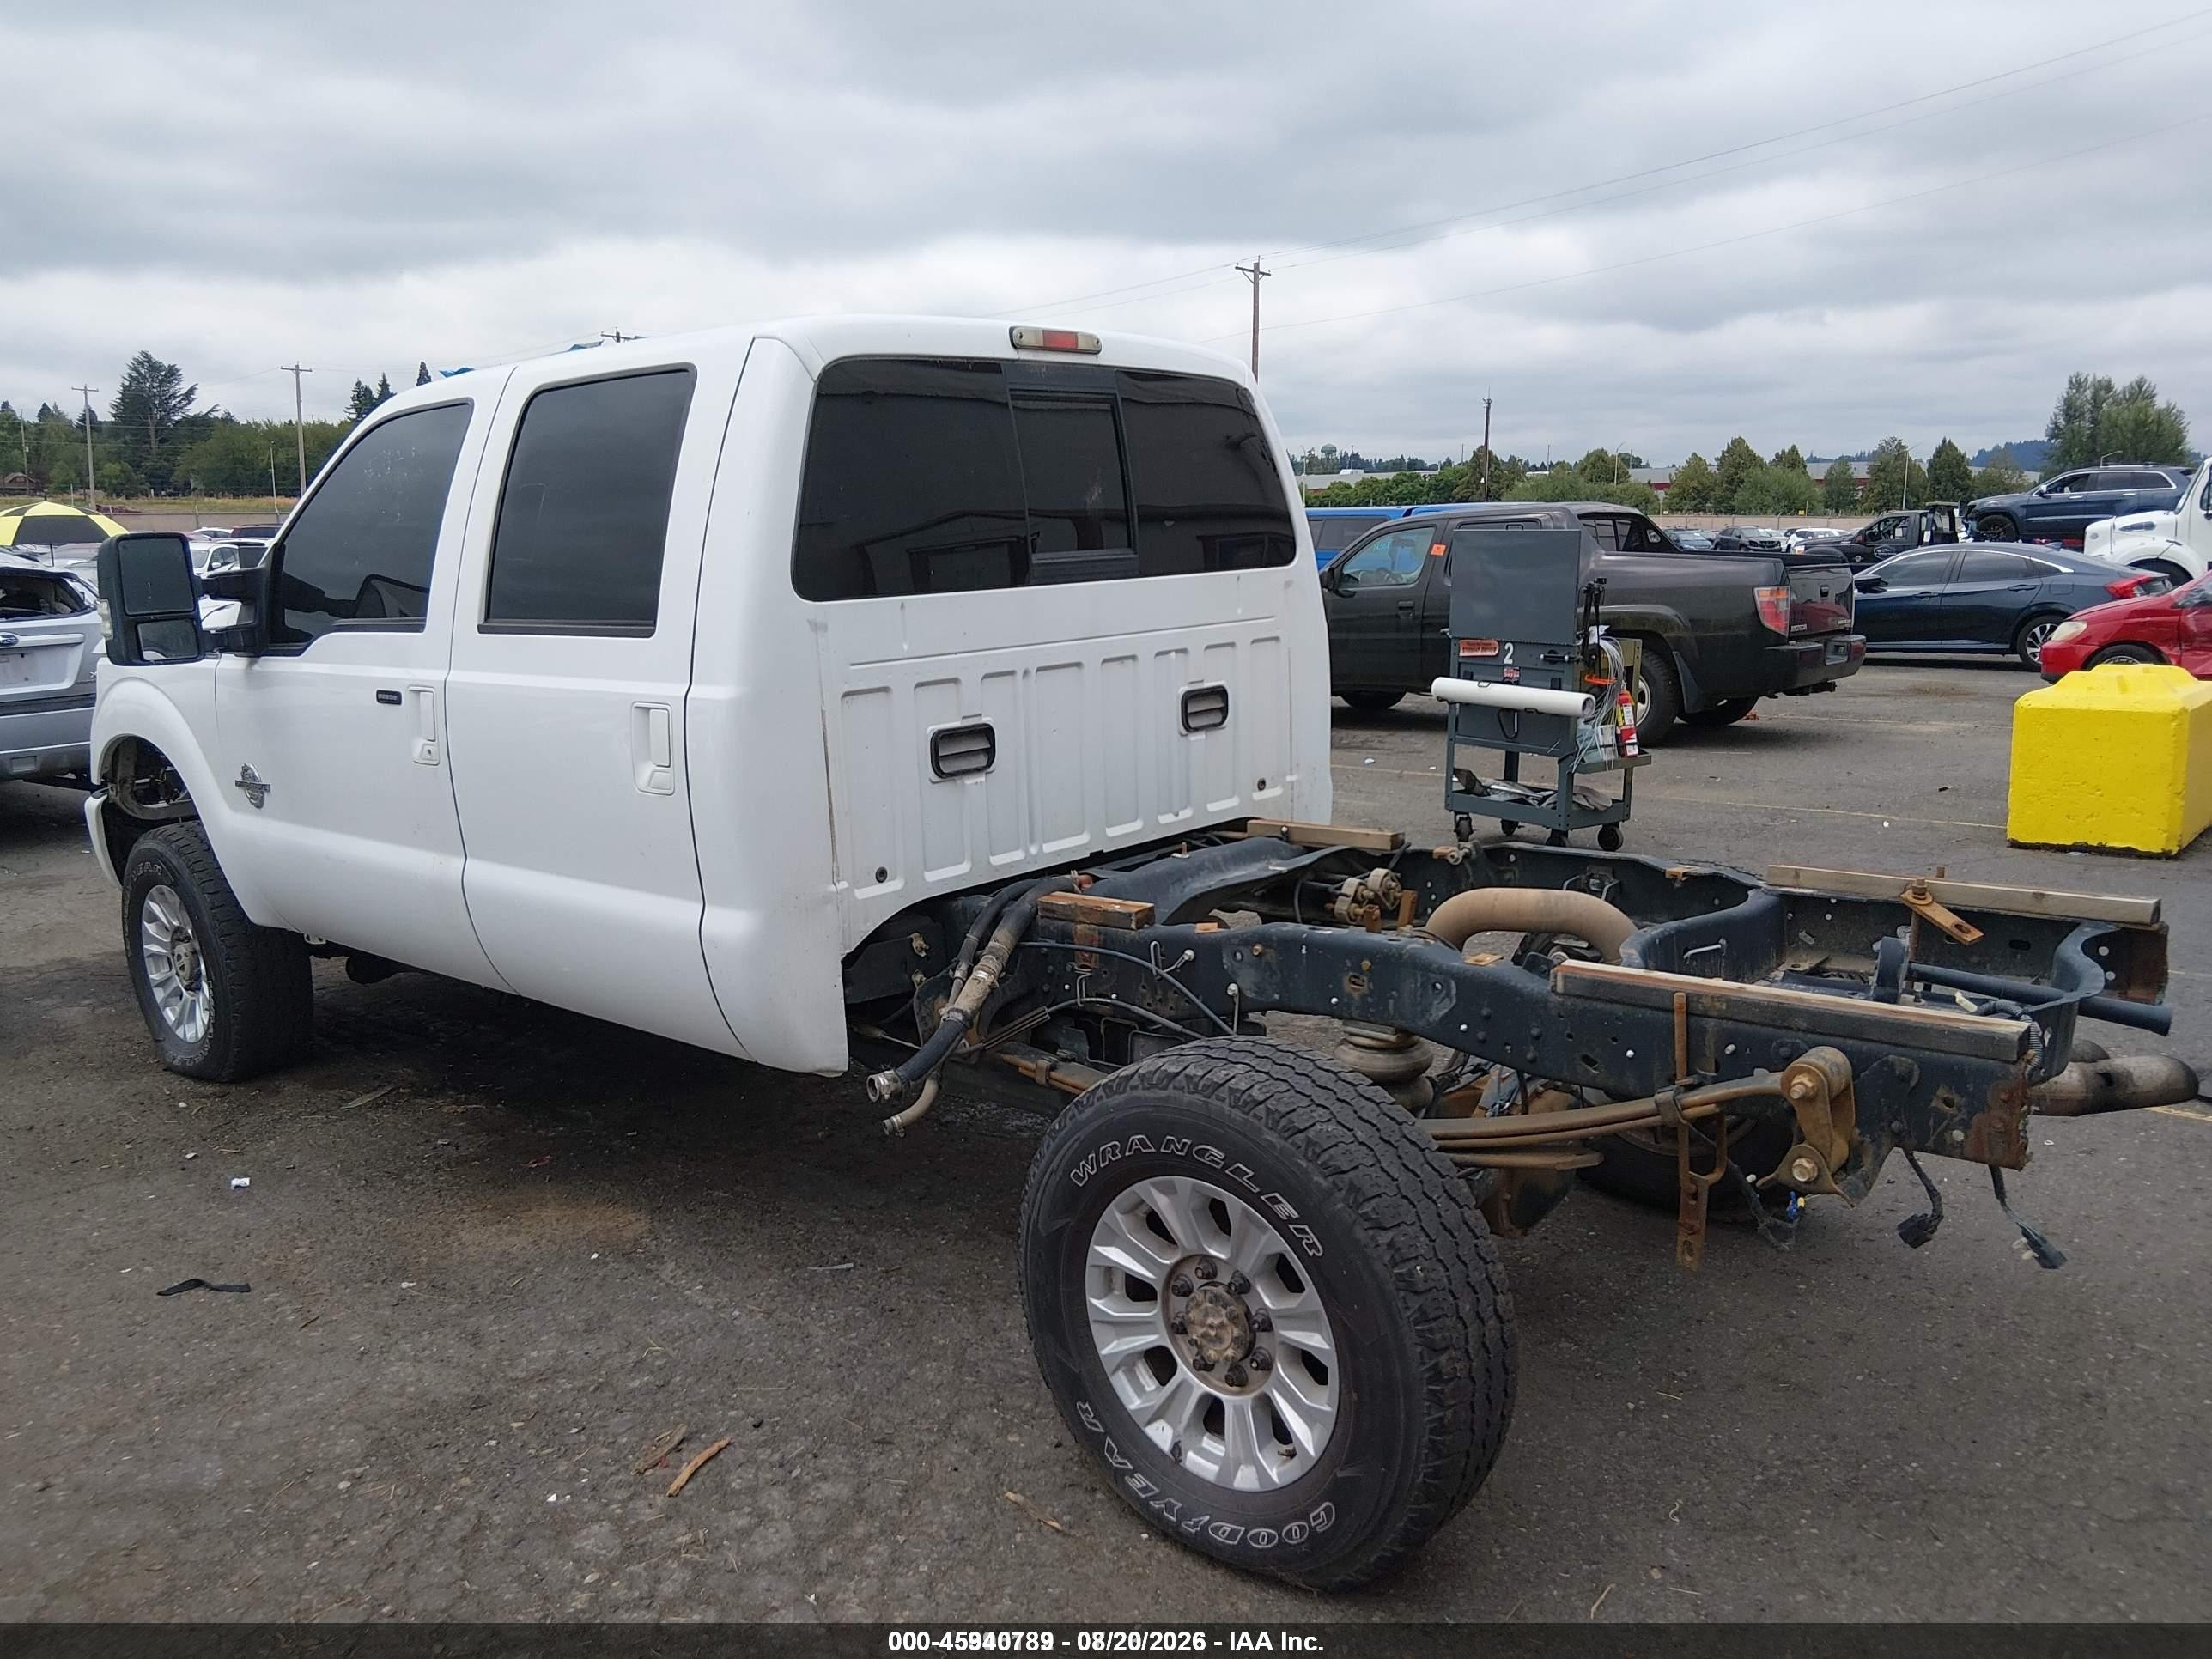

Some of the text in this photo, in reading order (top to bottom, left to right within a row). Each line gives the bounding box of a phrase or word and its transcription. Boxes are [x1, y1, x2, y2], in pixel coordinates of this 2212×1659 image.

[1504, 642, 1513, 664] 2
[1070, 1134, 1324, 1259] WRANGLER
[1076, 1401, 1336, 1548] GOODYEAR
